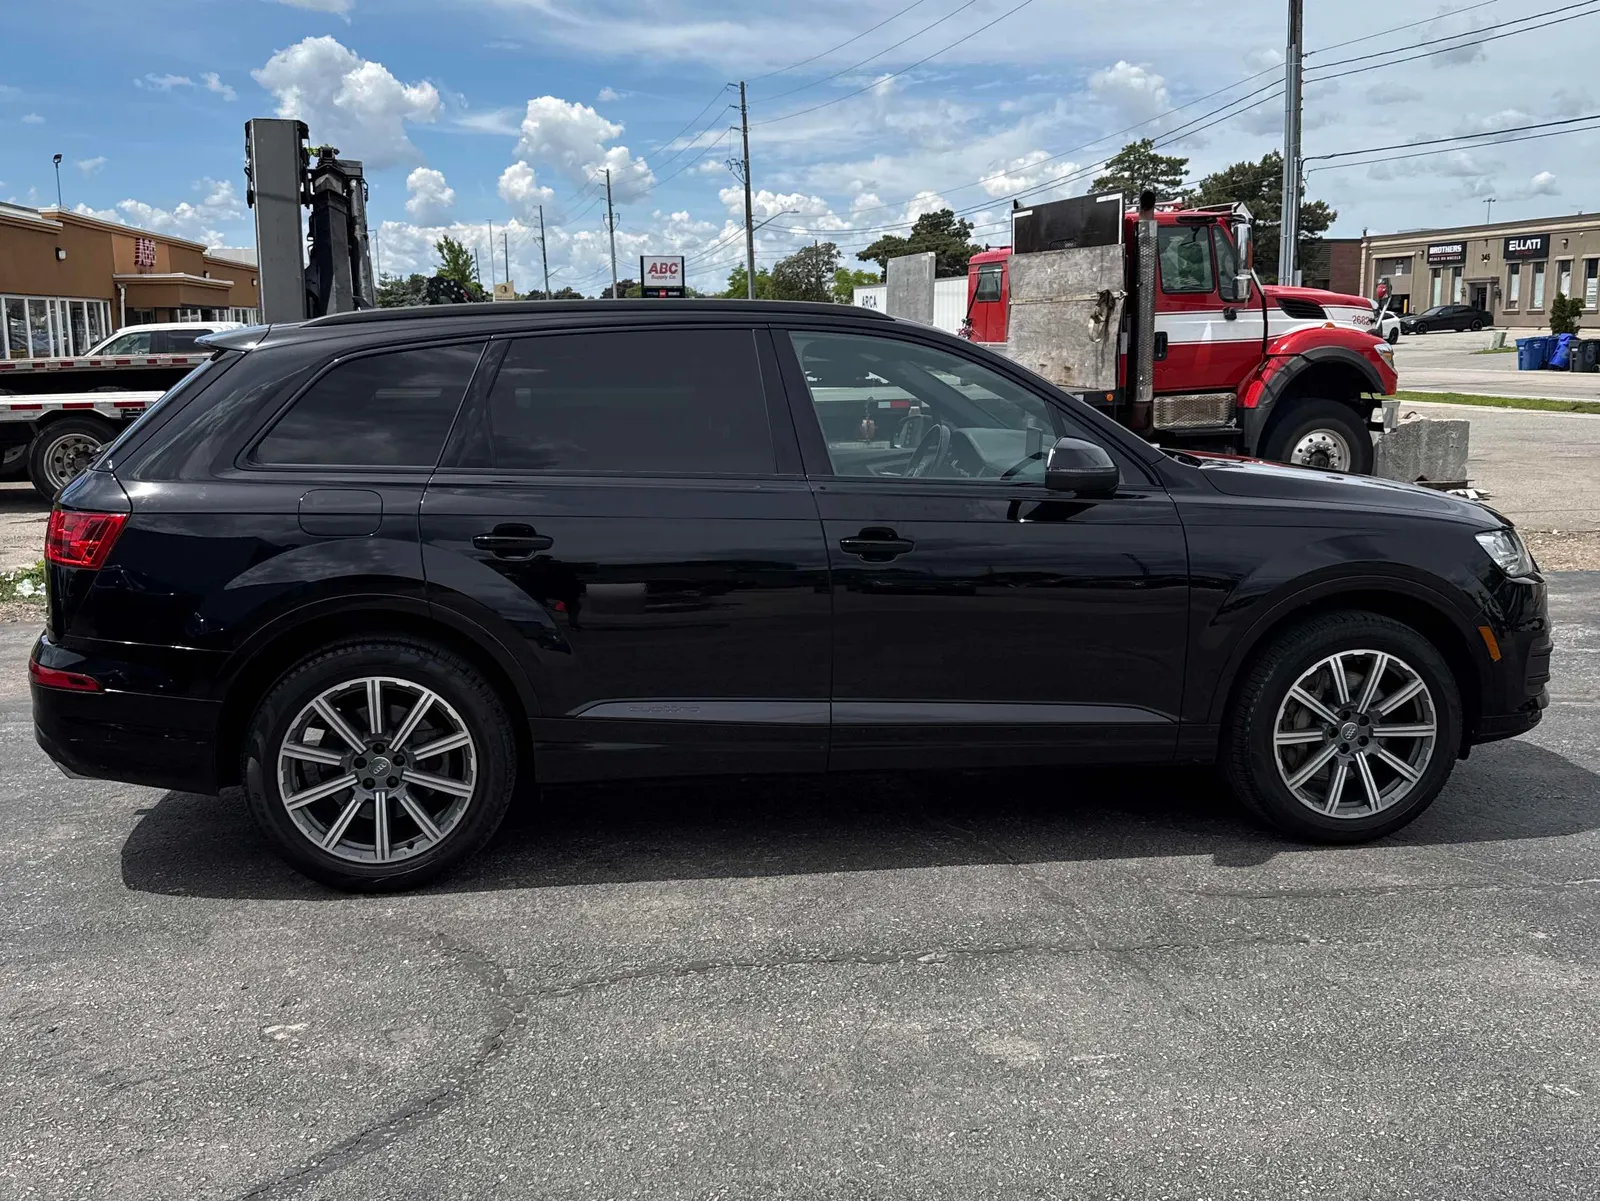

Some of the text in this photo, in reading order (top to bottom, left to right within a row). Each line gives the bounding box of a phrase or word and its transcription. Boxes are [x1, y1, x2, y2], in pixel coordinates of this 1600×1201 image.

[1429, 244, 1462, 254] BROTHERS
[1508, 238, 1541, 251] ELLATI
[1481, 253, 1491, 262] 345
[647, 262, 679, 275] ABC
